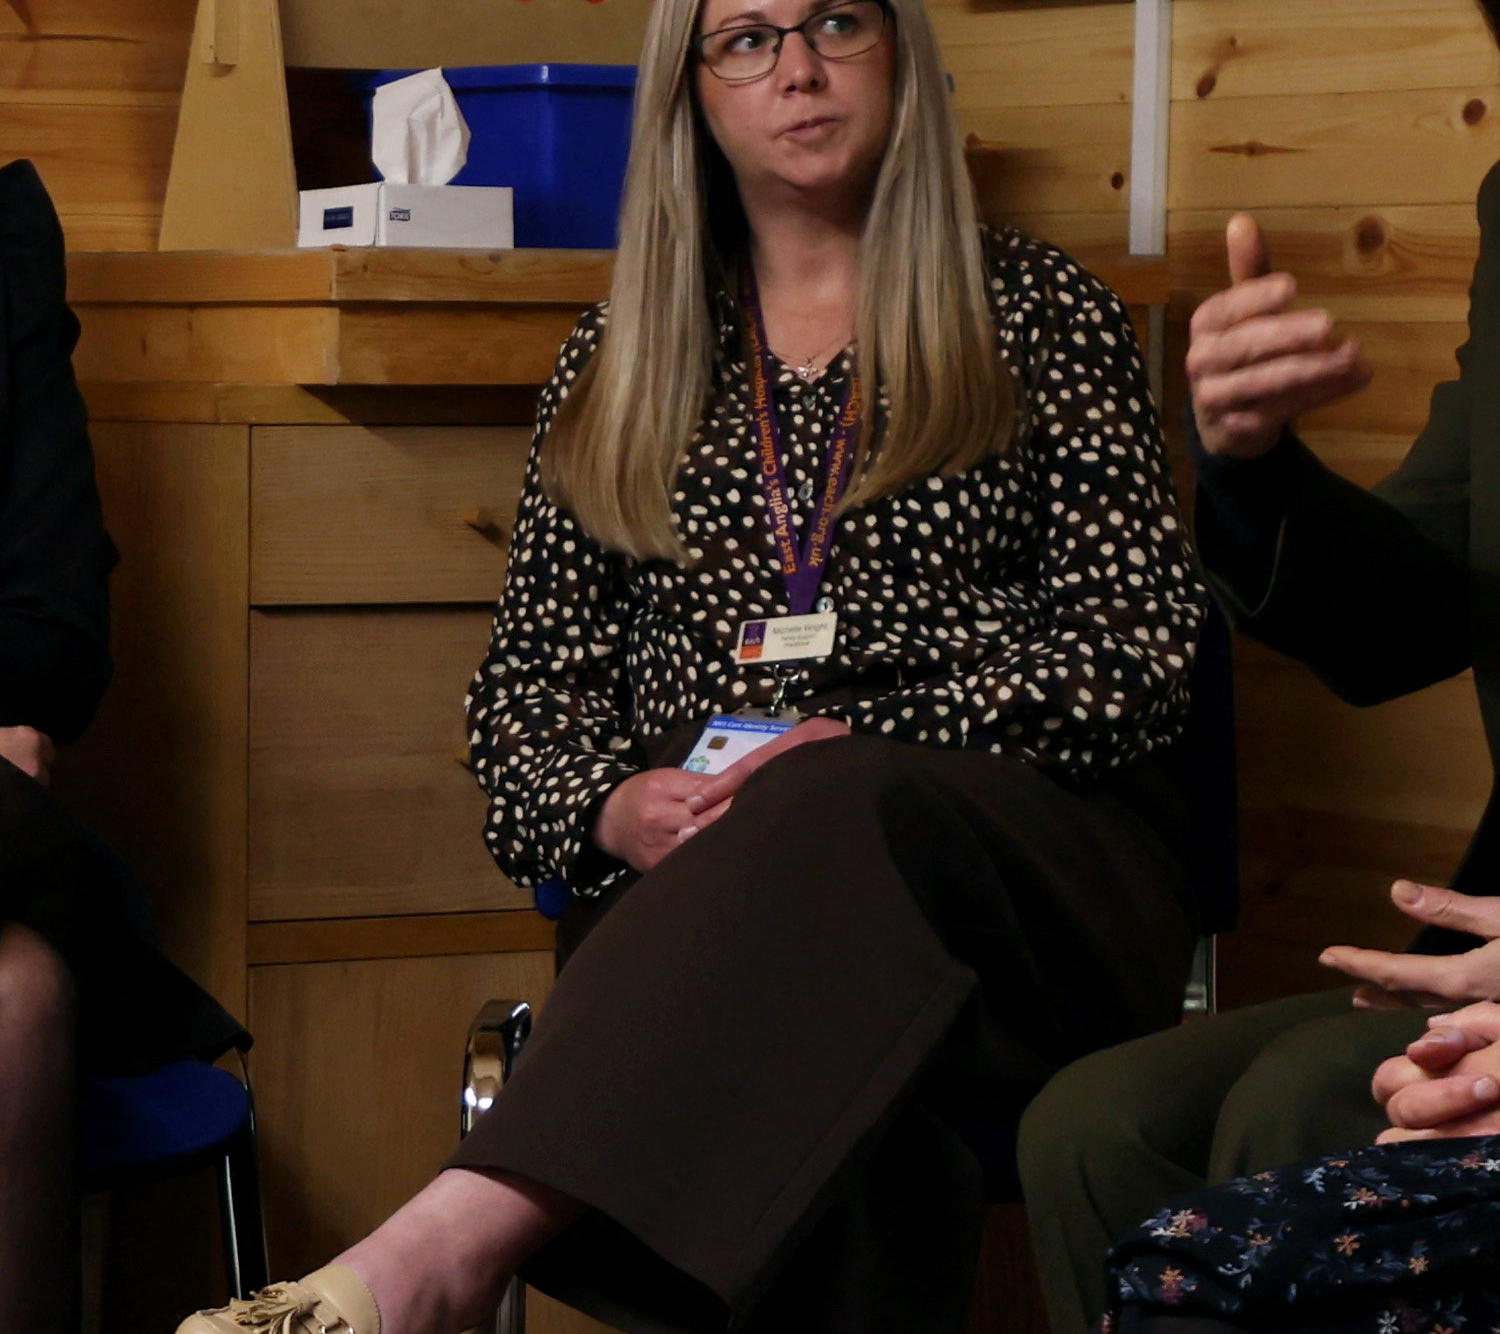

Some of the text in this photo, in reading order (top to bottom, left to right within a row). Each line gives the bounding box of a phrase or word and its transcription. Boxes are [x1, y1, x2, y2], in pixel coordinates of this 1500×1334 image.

[756, 410, 777, 476] Children's
[766, 478, 789, 537] Anglia's
[808, 439, 847, 567] www.each.org.uk
[780, 538, 797, 575] East
